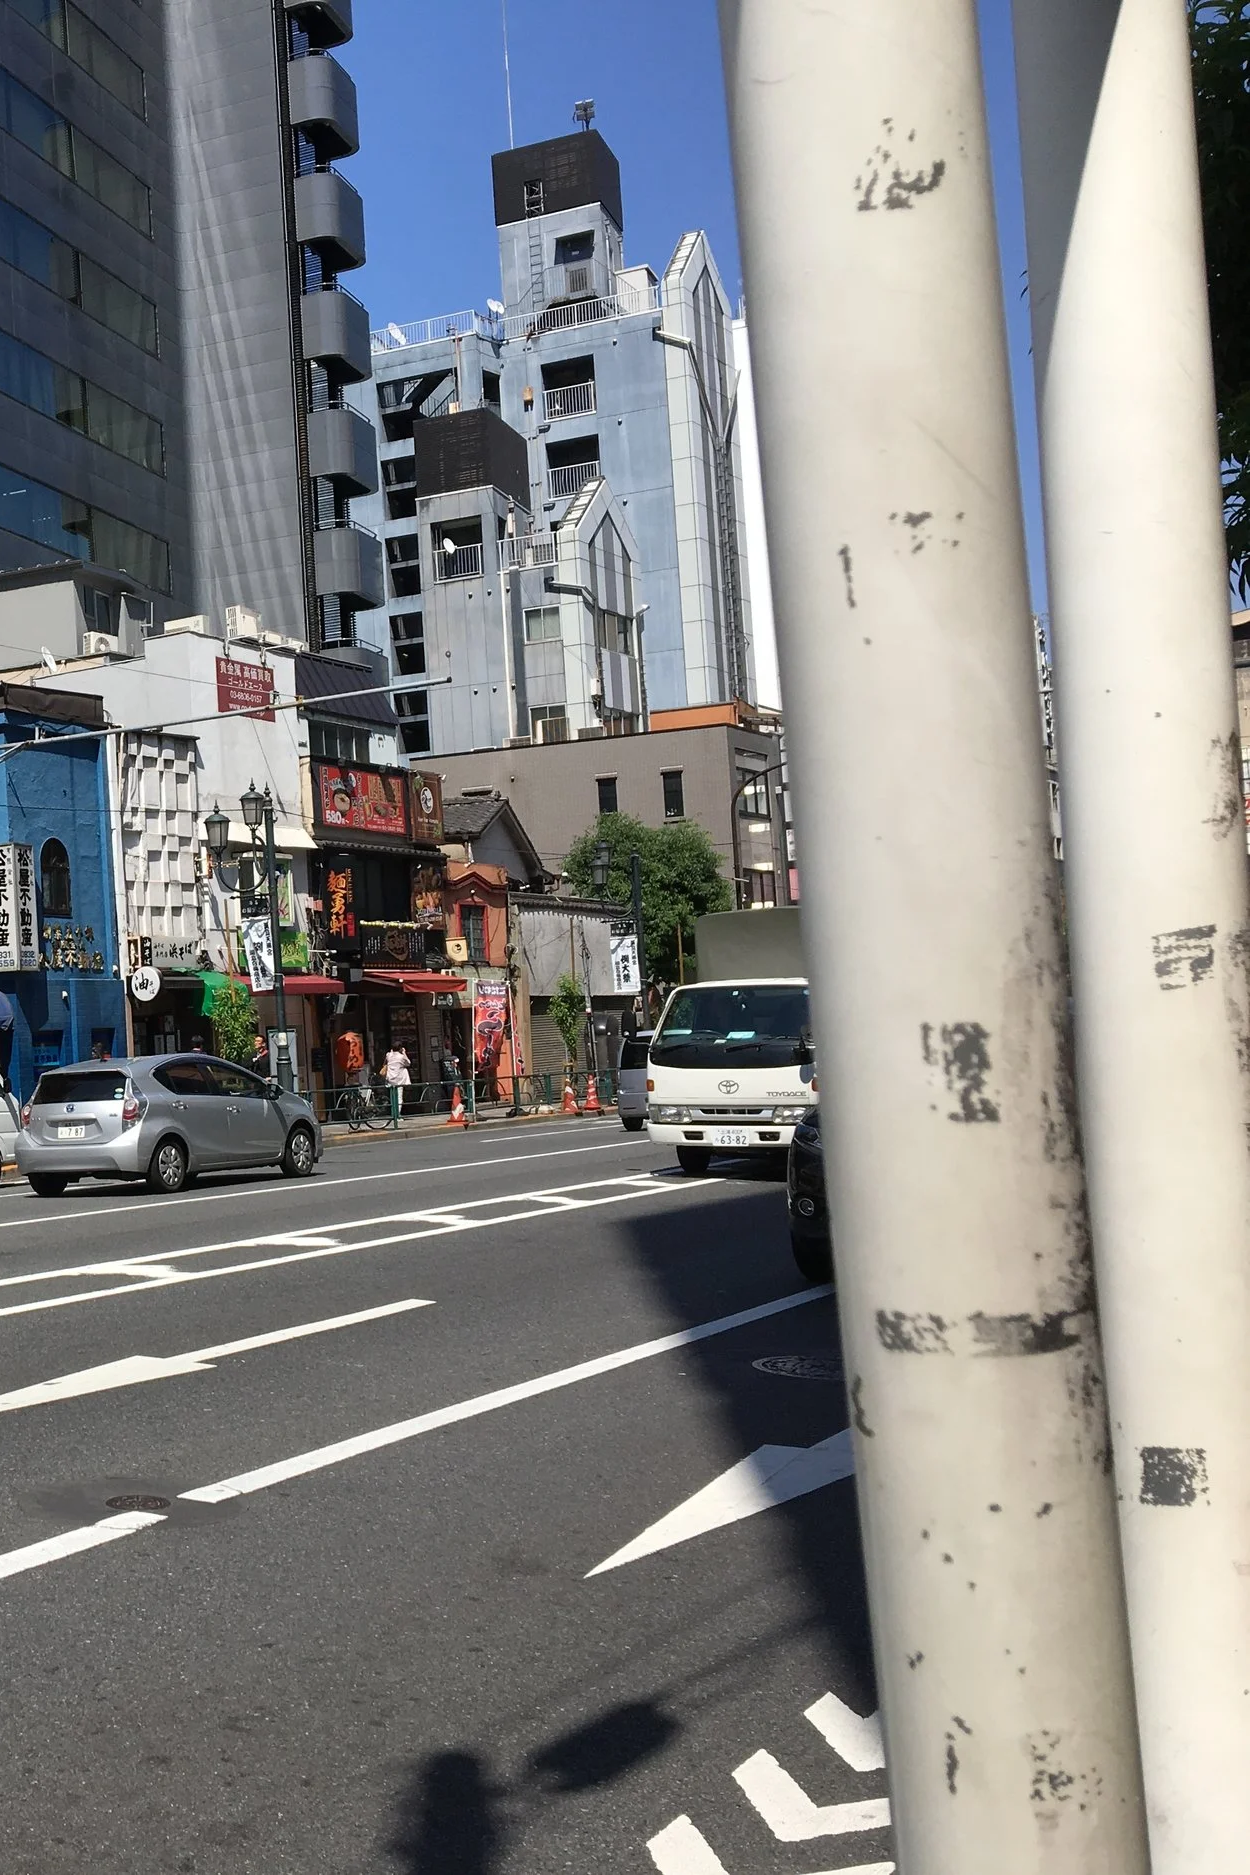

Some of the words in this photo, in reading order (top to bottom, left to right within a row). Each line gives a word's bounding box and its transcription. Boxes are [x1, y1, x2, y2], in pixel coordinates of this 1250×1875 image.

[17, 848, 33, 947] 松屋不動産
[134, 972, 150, 991] 油
[720, 1135, 747, 1145] 63-82
